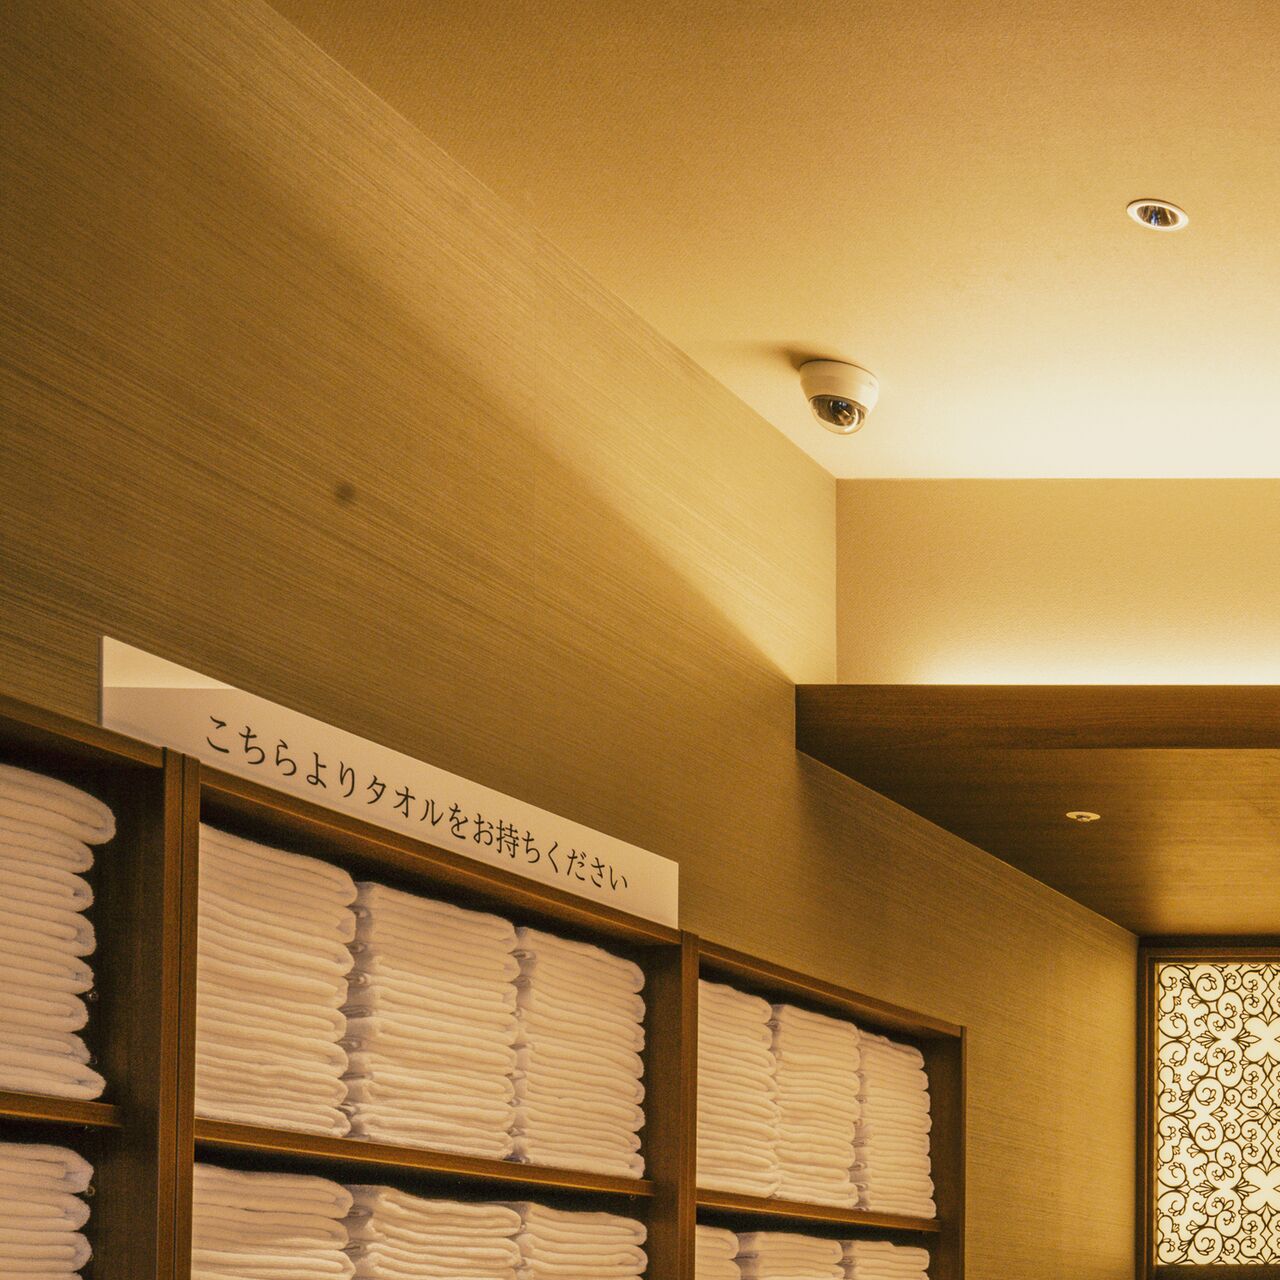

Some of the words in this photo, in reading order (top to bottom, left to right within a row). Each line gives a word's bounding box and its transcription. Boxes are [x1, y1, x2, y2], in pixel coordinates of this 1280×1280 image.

[205, 714, 628, 892] こちらよりタオルをお持ちください
